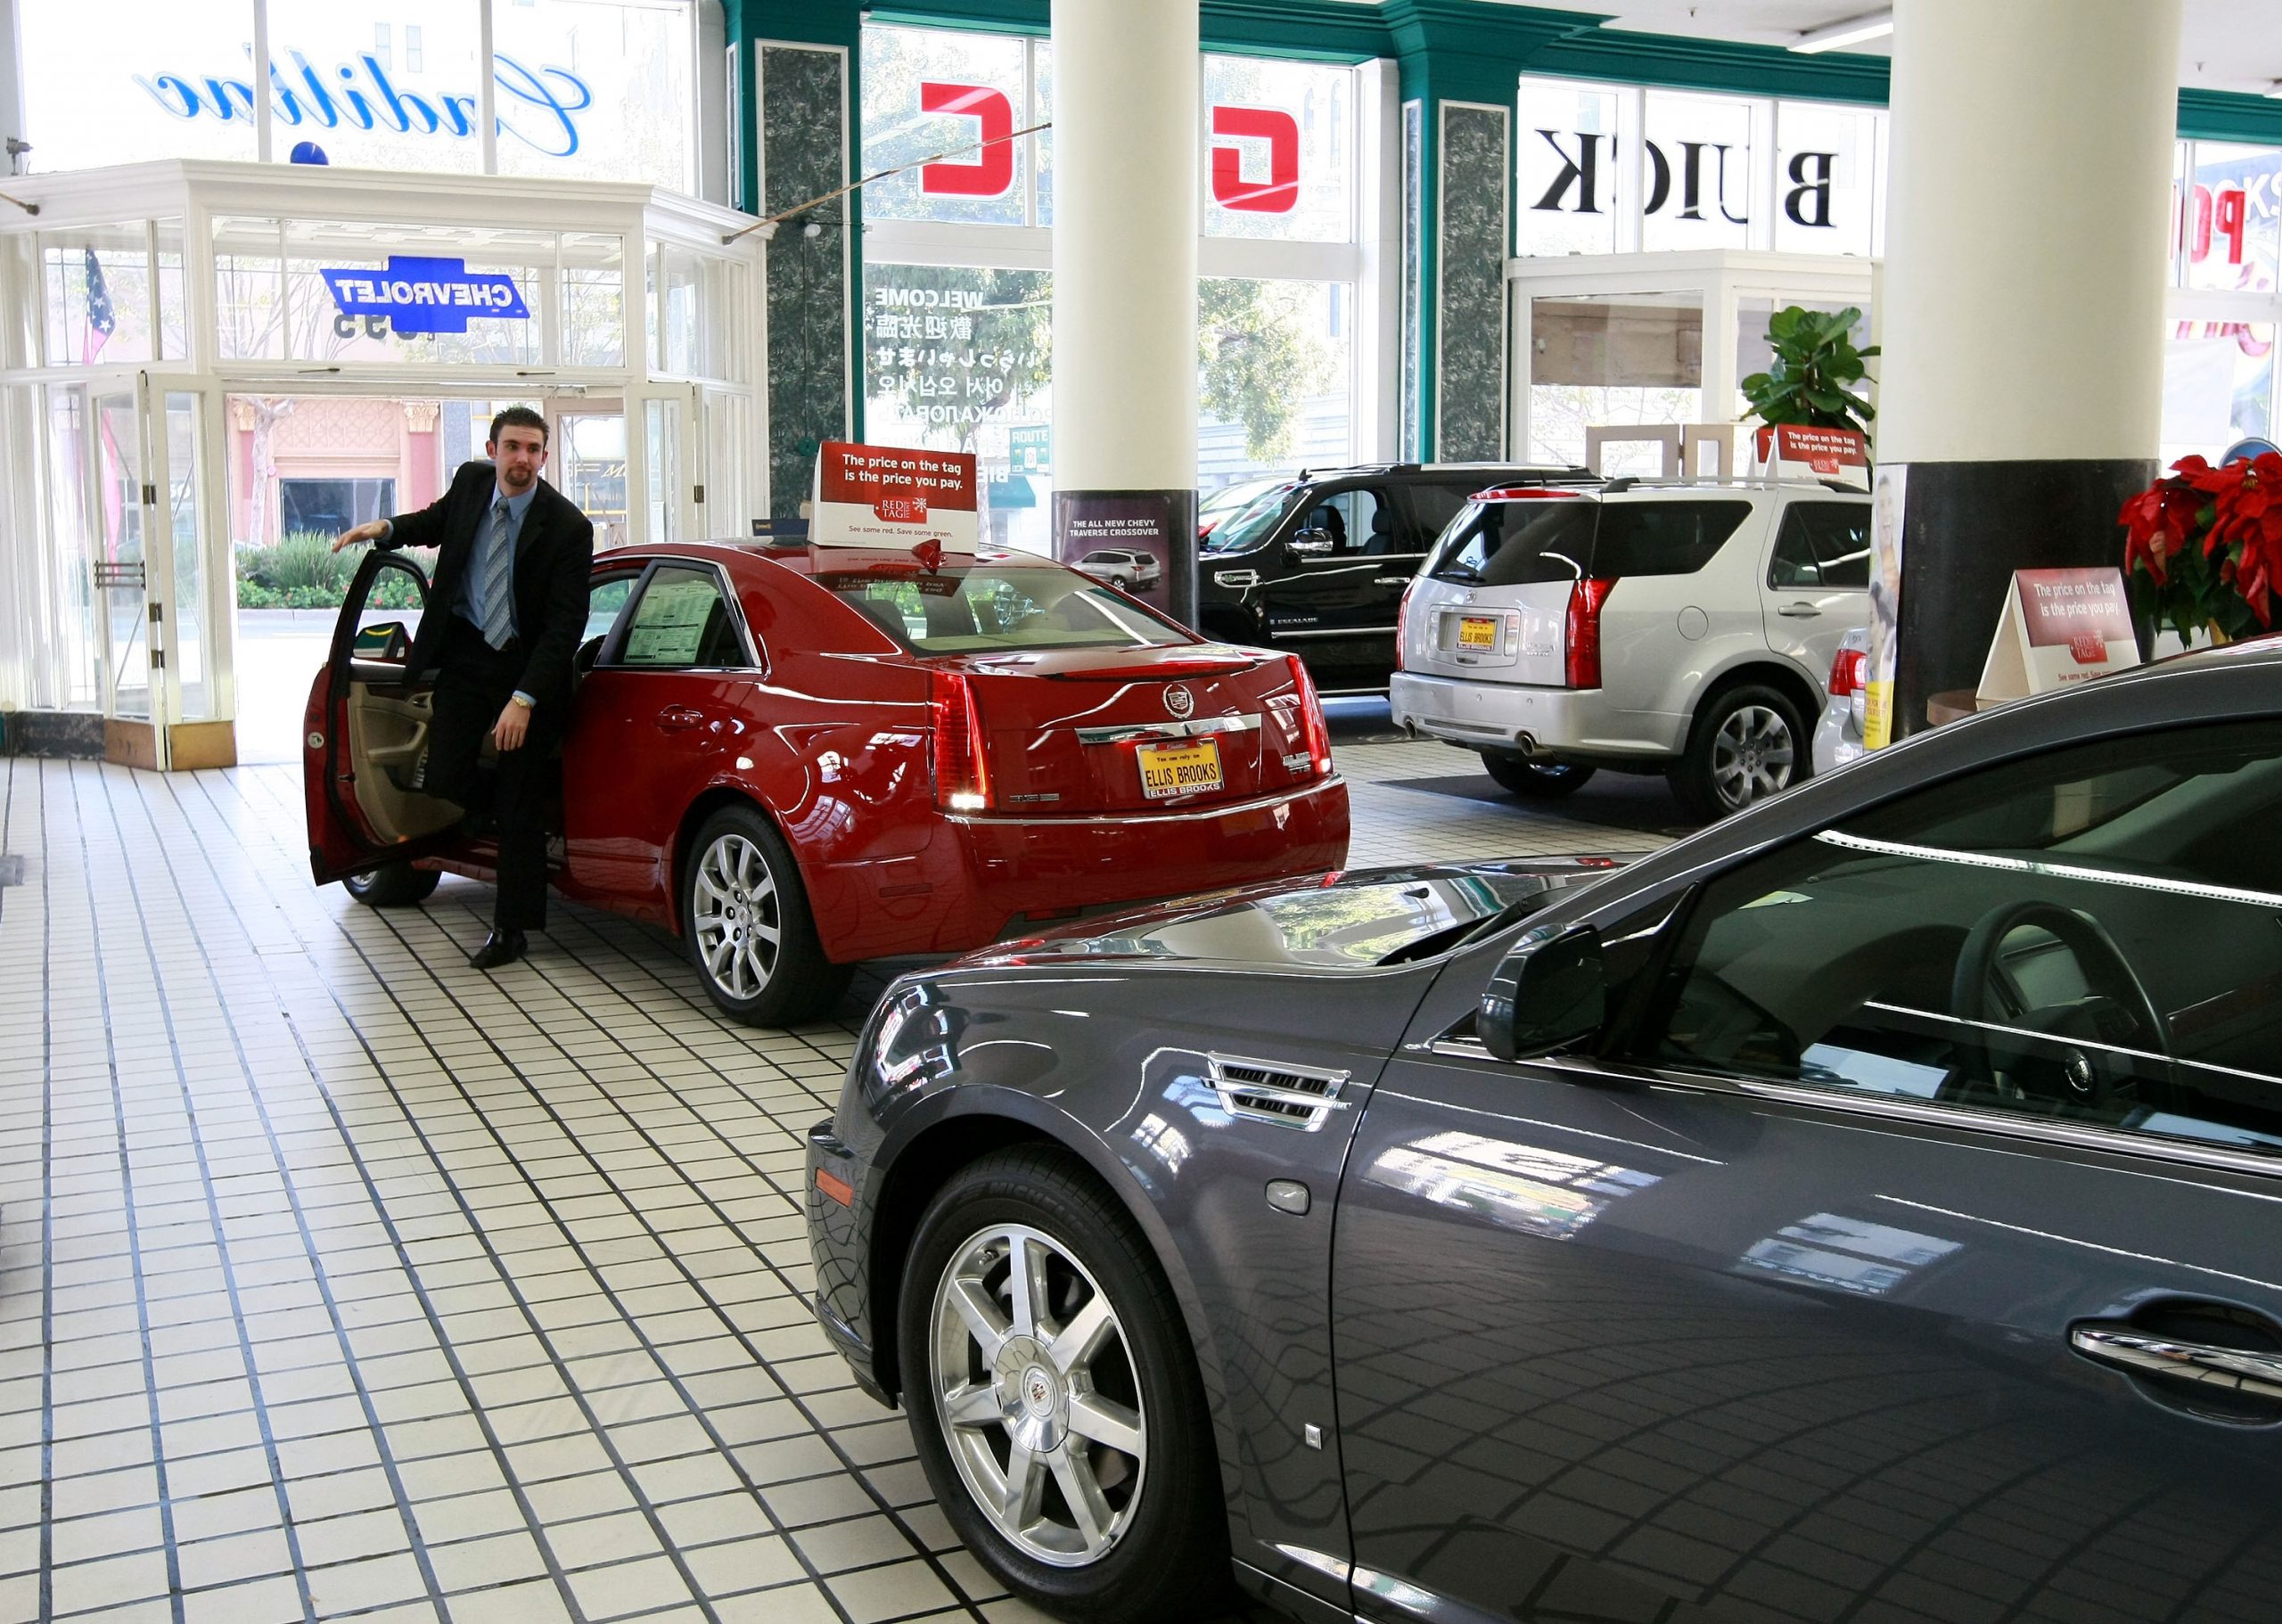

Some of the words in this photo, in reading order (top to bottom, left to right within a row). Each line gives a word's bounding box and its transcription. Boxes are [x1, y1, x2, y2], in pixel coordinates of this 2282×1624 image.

[1013, 430, 1048, 444] ROUTE
[1787, 431, 1801, 440] The
[1802, 433, 1818, 442] price
[1831, 435, 1843, 444] the
[1844, 437, 1855, 446] tag
[1798, 441, 1810, 449] the
[1811, 443, 1828, 452] price
[1829, 446, 1842, 454] you
[1843, 446, 1857, 455] pay.
[842, 454, 865, 466] The
[868, 455, 898, 469] price
[901, 461, 915, 470] on
[919, 460, 939, 472] the
[941, 463, 962, 476] tag
[845, 470, 856, 481] is
[858, 471, 879, 482] the
[882, 472, 912, 485] price
[915, 477, 936, 488] you
[940, 479, 963, 490] pay.
[882, 500, 904, 510] RED
[882, 509, 904, 519] TAG
[882, 526, 895, 535] red.
[1110, 529, 1159, 537] CROSSOVER
[2033, 583, 2051, 598] The
[2053, 581, 2073, 599] price
[2075, 584, 2086, 595] on
[2086, 581, 2102, 595] the
[2101, 581, 2116, 596] tag
[2040, 603, 2049, 617] is
[2050, 601, 2065, 617] the
[2067, 601, 2087, 619] price
[2088, 603, 2104, 617] you
[1277, 617, 1318, 625] ESCALADE
[1459, 631, 1473, 643] ELLIS
[1473, 632, 1493, 644] BROOKS
[1145, 767, 1173, 787] ELLIS
[1177, 763, 1217, 783] BROOKS
[1150, 787, 1178, 798] ELLIS
[1178, 783, 1220, 794] BROOKS
